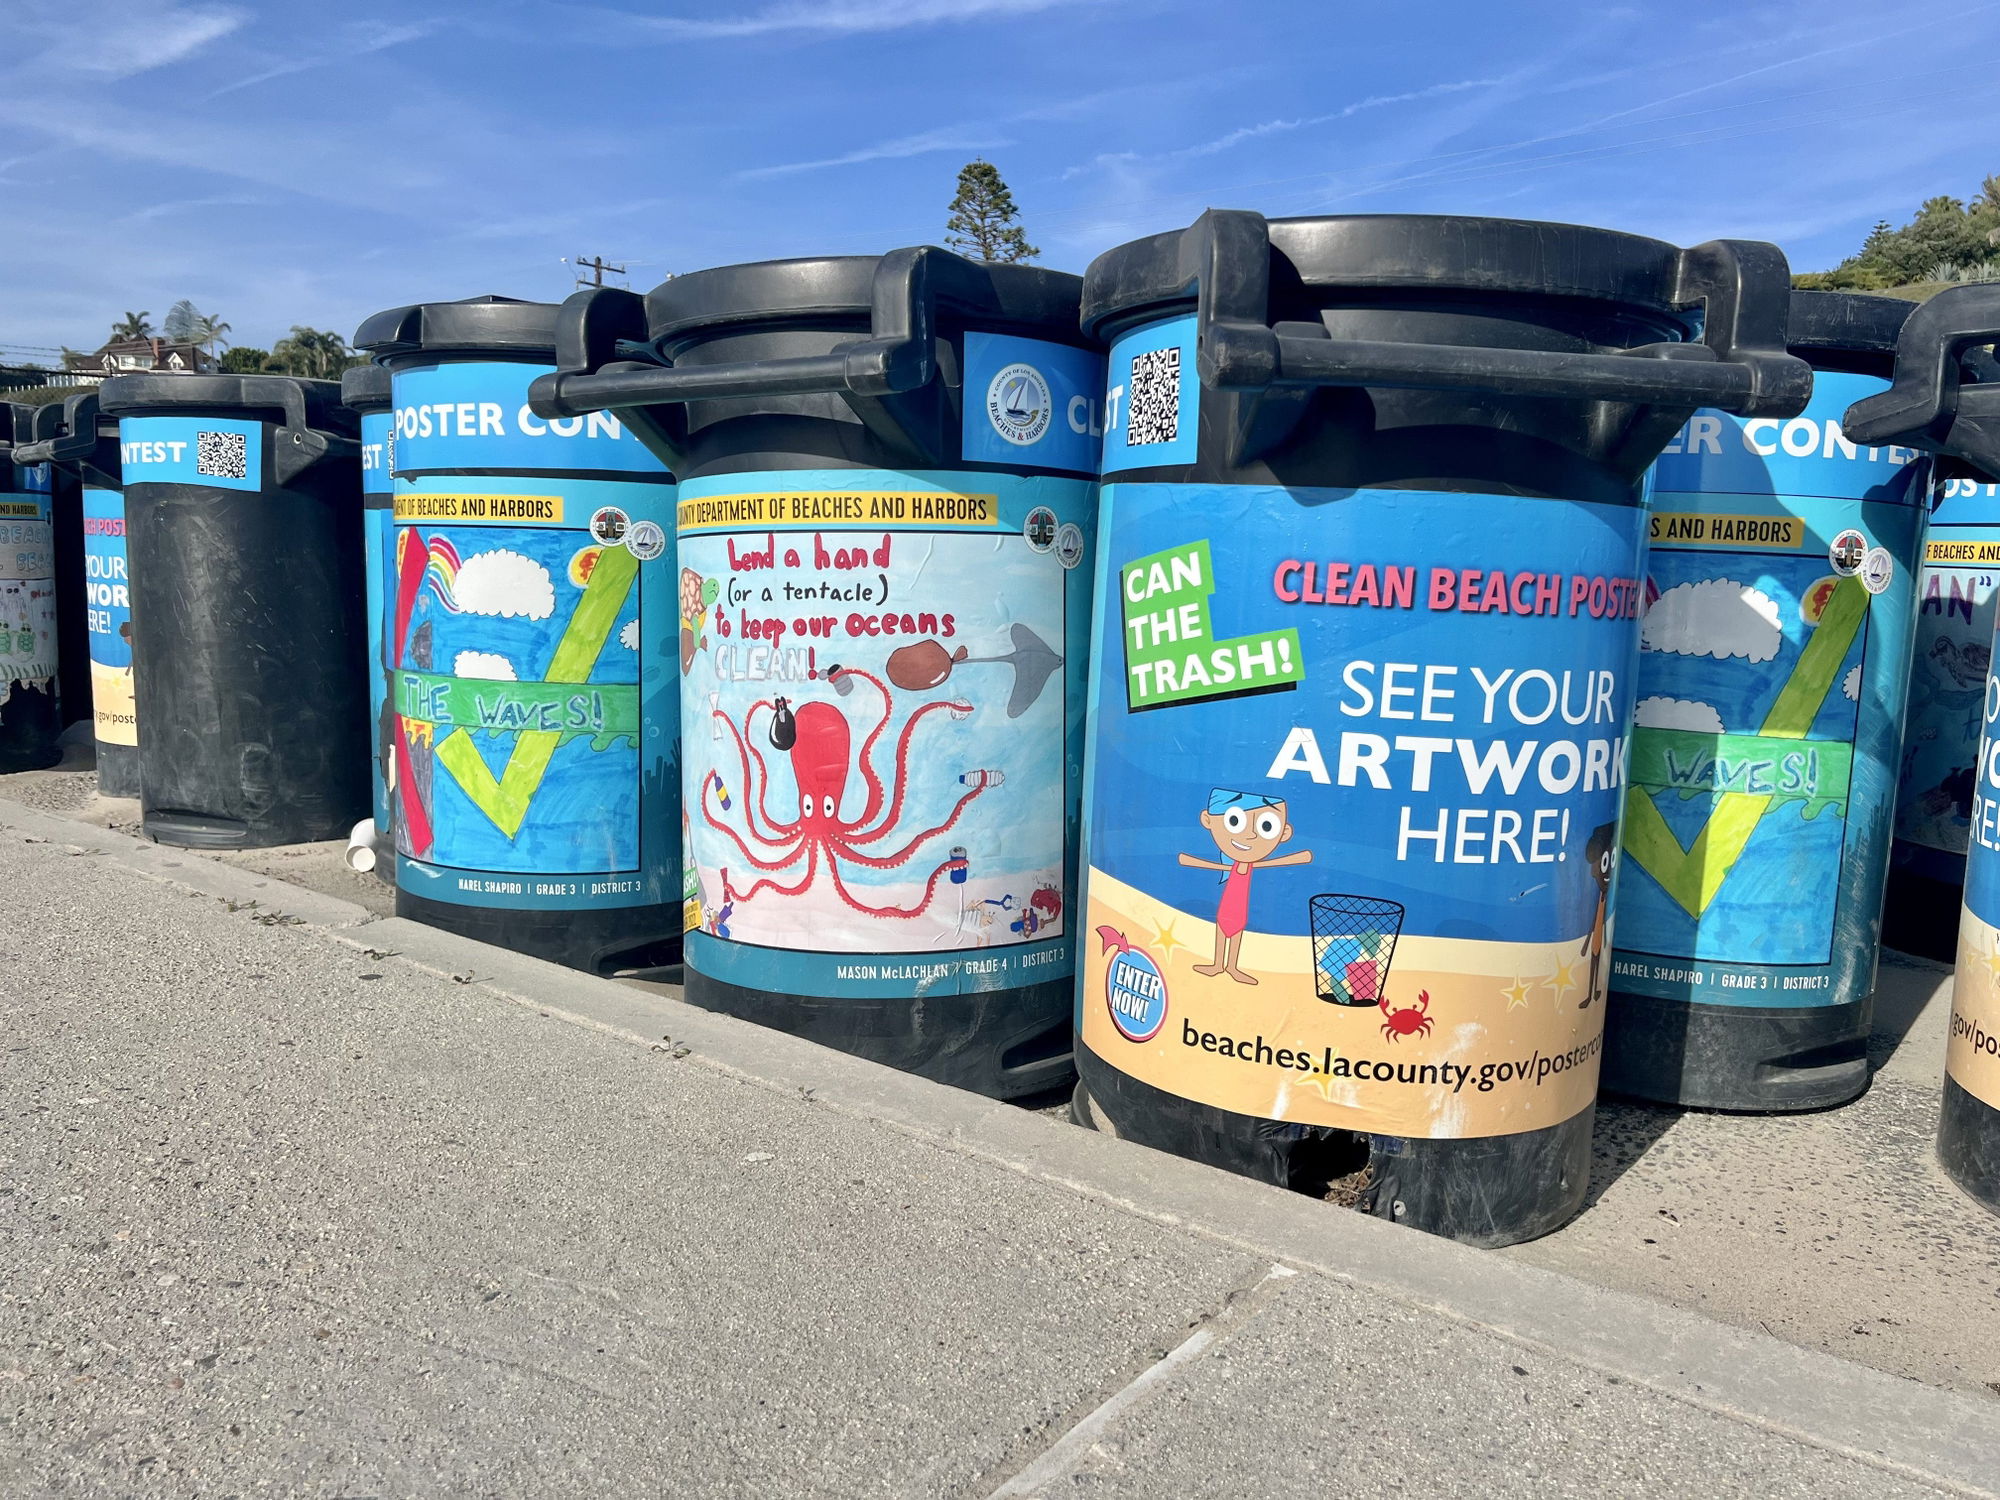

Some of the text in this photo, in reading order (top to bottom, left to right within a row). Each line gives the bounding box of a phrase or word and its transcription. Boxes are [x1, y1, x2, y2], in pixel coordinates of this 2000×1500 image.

[395, 402, 505, 441] POSTER
[990, 401, 1050, 440] BEACHES & HARBORS
[417, 499, 457, 516] BEACHES
[461, 499, 486, 516] AND
[490, 500, 554, 518] HARBORS
[697, 498, 764, 523] DEPARTMENT
[769, 498, 786, 519] OF
[792, 497, 862, 517] BEACHES
[869, 497, 905, 518] AND
[911, 498, 987, 520] HARBORS
[1667, 518, 1705, 539] AND
[1711, 518, 1792, 542] HARBORS
[784, 548, 800, 567] a
[814, 532, 891, 571] hand
[1933, 545, 1975, 560] BEACHES
[727, 574, 888, 607] (or a tentacle)
[1126, 551, 1202, 603] CAN
[1273, 559, 1416, 608] CLEAN
[1427, 569, 1562, 617] BEACH
[715, 603, 956, 649] to keep our oceans
[1128, 602, 1203, 650] THE
[1131, 637, 1294, 697] TRASH!
[404, 676, 606, 733] THE WAVES!
[1340, 660, 1616, 726] SEE YOUR
[1266, 727, 1630, 796] ARTWORK
[1666, 748, 1819, 795] WAVES!
[1396, 806, 1570, 864] HERE!
[485, 881, 521, 894] SHAPIRO
[536, 884, 565, 895] GRADE
[569, 884, 576, 895] 3
[591, 881, 632, 894] DISTRICT
[635, 880, 641, 892] 3
[837, 965, 877, 979] MASON
[881, 964, 949, 979] McLACHLAN
[965, 958, 998, 975] GRADE
[1001, 957, 1007, 971] 4
[1022, 950, 1058, 968] DISTRICT
[1059, 947, 1065, 960] 3
[1115, 960, 1162, 1001] ENTER
[1614, 961, 1650, 979] HAREL
[1653, 966, 1703, 985] SHAPIRO
[1721, 975, 1757, 989] GRADE
[1760, 975, 1767, 989] 3
[1783, 976, 1822, 990] DISTRICT
[1823, 975, 1829, 988] 3
[1111, 985, 1149, 1024] NOW!
